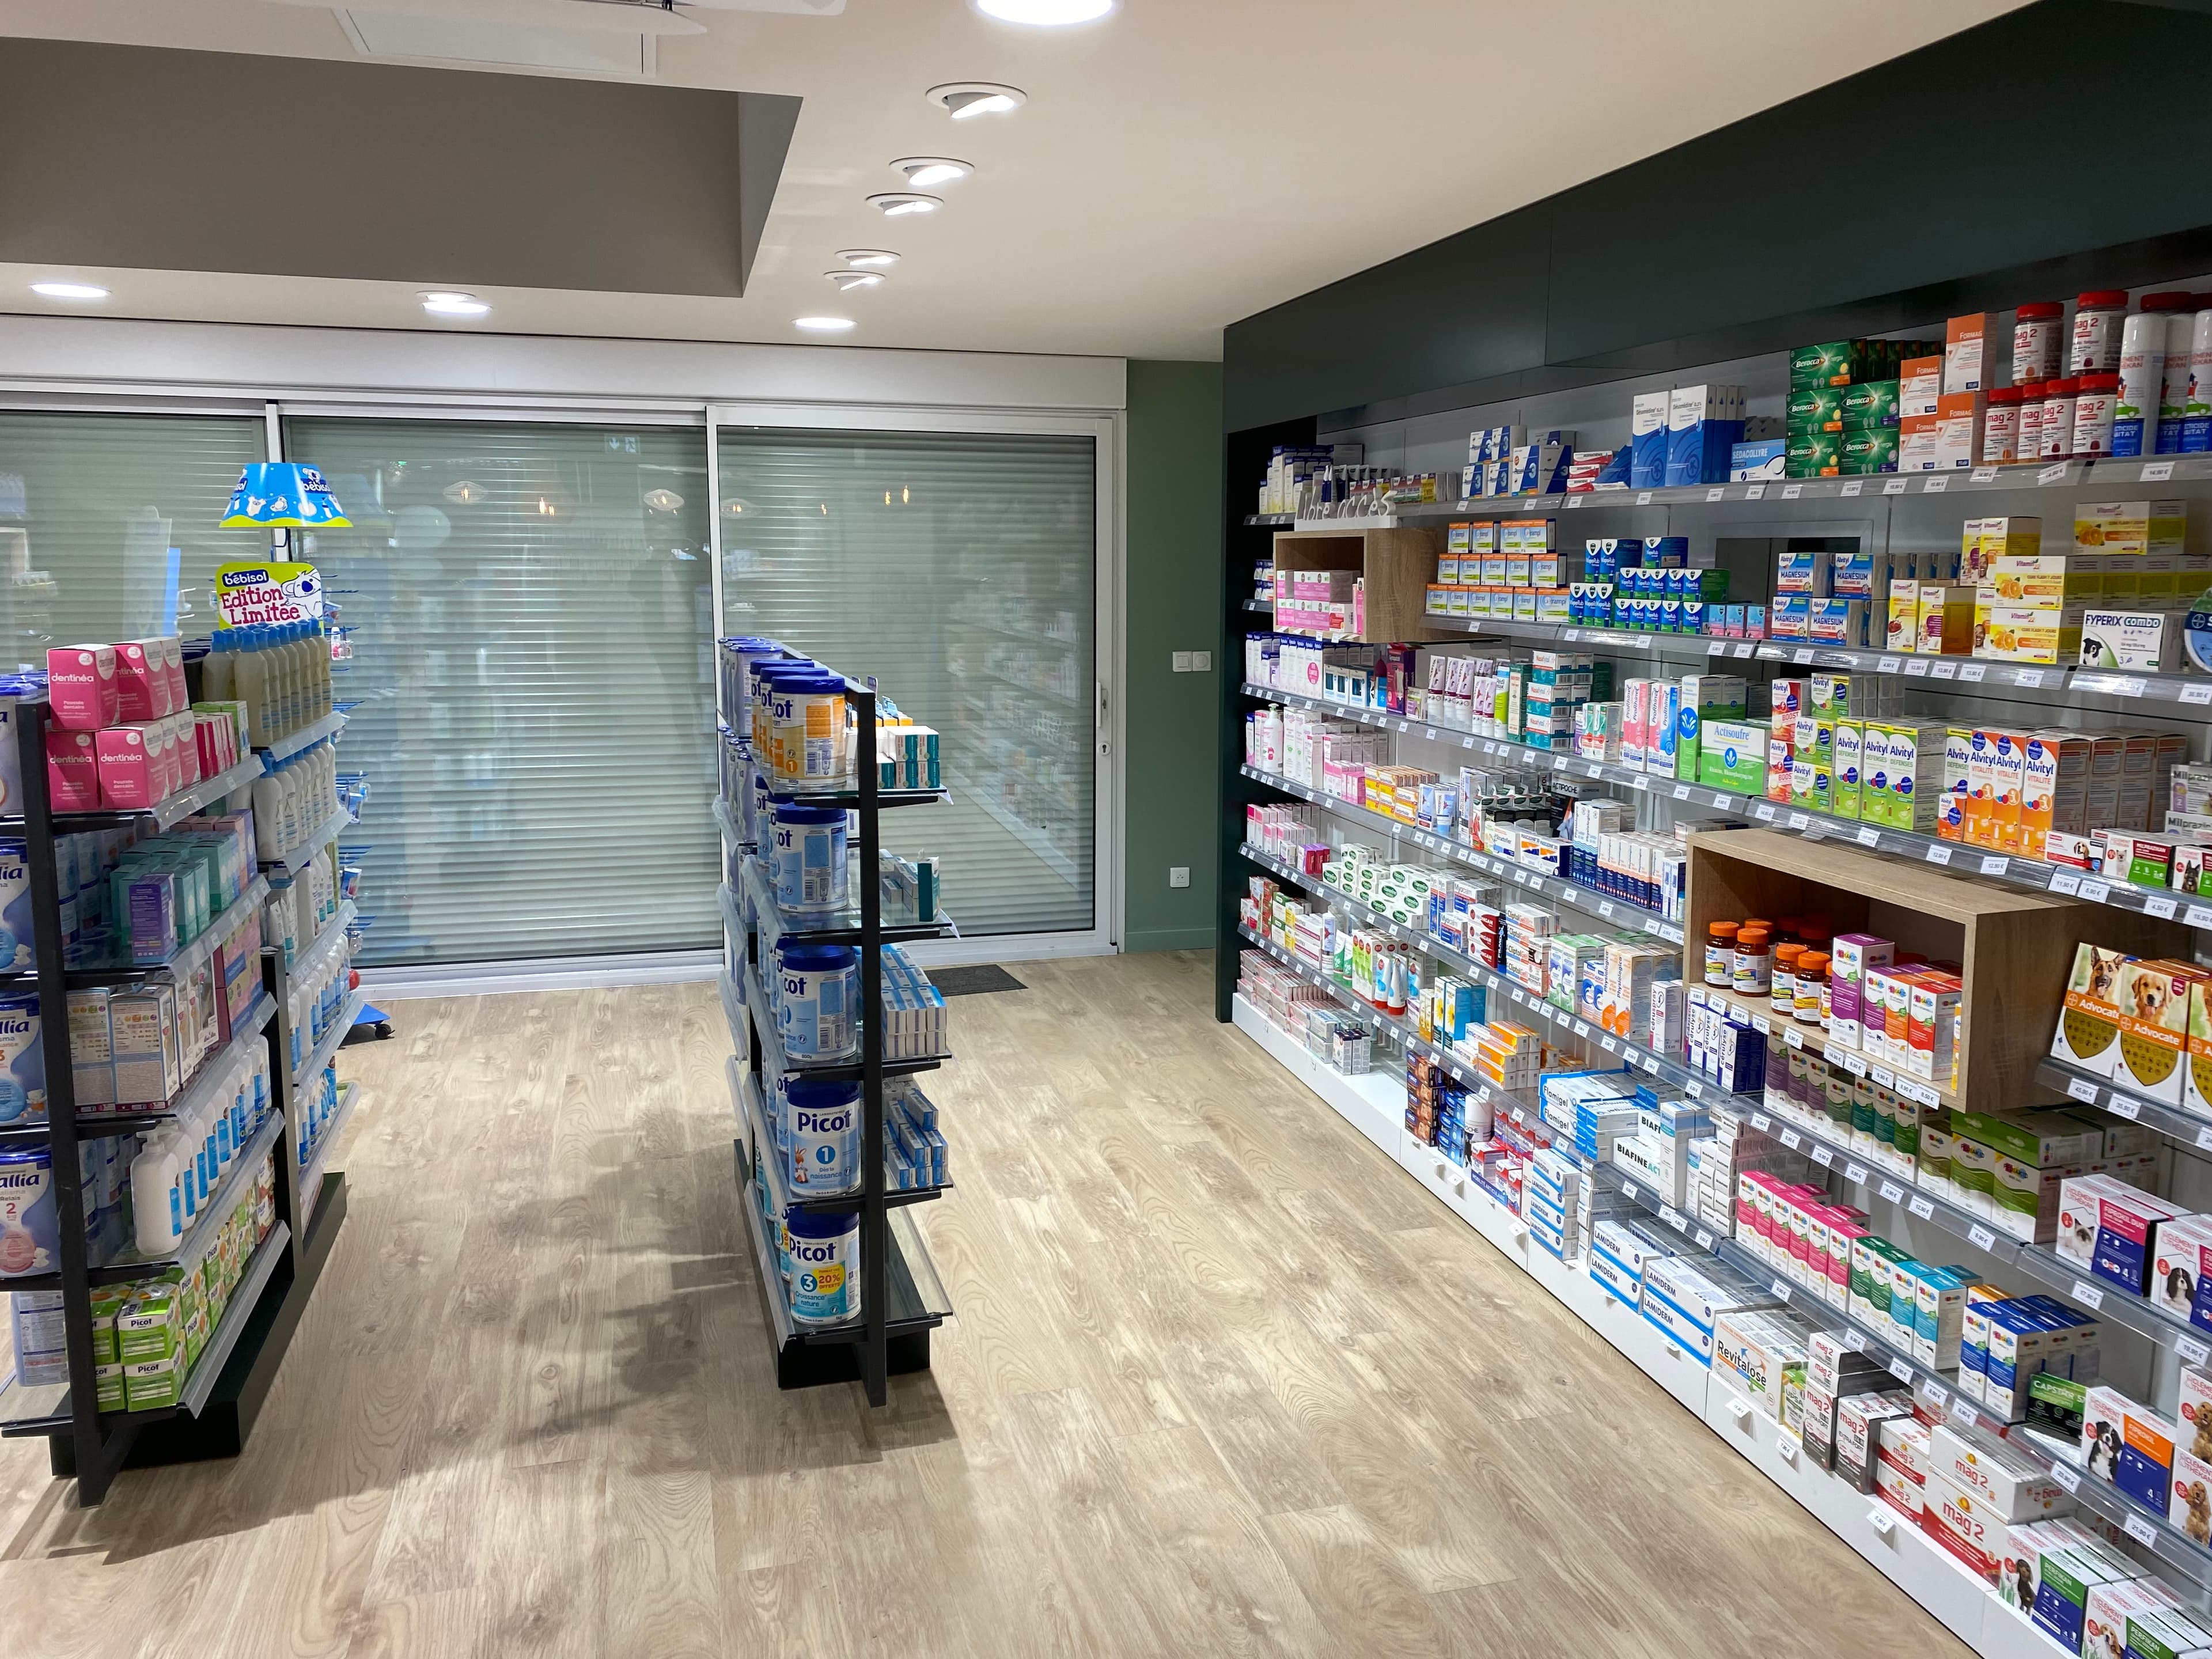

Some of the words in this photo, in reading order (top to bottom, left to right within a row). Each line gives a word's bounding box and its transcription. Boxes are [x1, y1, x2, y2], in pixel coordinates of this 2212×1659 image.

[2090, 317, 2099, 327] 2
[2030, 328, 2037, 338] 2
[2056, 404, 2065, 414] 2
[2077, 403, 2094, 413] mag
[2096, 400, 2105, 411] 2
[1987, 414, 2005, 424] mag
[2007, 412, 2015, 421] 2
[2022, 411, 2040, 421] mag
[1790, 448, 1812, 456] Berocca
[224, 573, 267, 585] bébisol
[219, 586, 284, 609] Edition
[229, 602, 301, 625] Limitée
[2085, 614, 2122, 627] FYPERIX
[2125, 618, 2160, 627] combo
[51, 673, 94, 682] dentinéa
[1813, 676, 1830, 688] Alvityl
[1773, 683, 1788, 693] Alvityl
[1782, 711, 1799, 721] BOOST
[1714, 725, 1749, 740] Actisoufre
[1797, 721, 1813, 733] Alvityl
[1771, 743, 1785, 753] Alvityl
[1838, 737, 1859, 751] Alvityl
[1866, 741, 1888, 756] Alvityl
[50, 753, 92, 763] dentinéa
[100, 753, 142, 762] dentinéa
[1890, 745, 1914, 760] Alvityl
[1947, 748, 1969, 763] Alvity
[1970, 751, 1996, 767] Alvityl
[1794, 765, 1811, 776] Alvityl
[1997, 756, 2021, 771] Alvityl
[2026, 760, 2054, 777] Alvityl
[1778, 773, 1792, 781] BOOS
[1552, 782, 1578, 794] ACTIPOCHE
[2134, 1023, 2180, 1046] Advocate
[1544, 1085, 1569, 1107] Flamigel
[797, 1110, 851, 1132] Picot
[1545, 1108, 1569, 1130] Flamigel
[821, 1147, 830, 1162] 1
[0, 1173, 40, 1188] allia
[1532, 1179, 1550, 1197] LAMIDERM
[6, 1202, 16, 1214] 2
[1531, 1200, 1549, 1218] LAMIDERM
[1530, 1221, 1548, 1239] LAMIDERM
[790, 1236, 836, 1262] Picot
[1594, 1229, 1621, 1256] LAMIDERM
[1592, 1257, 1618, 1284] LAMIDERM
[803, 1275, 813, 1290] 3
[819, 1274, 840, 1284] 20%
[1646, 1269, 1676, 1297] LAMIDERM
[1644, 1297, 1673, 1326] LAMIDERM
[131, 1319, 151, 1327] Picot
[1815, 1340, 1828, 1355] mag
[1828, 1348, 1834, 1356] 2
[138, 1363, 160, 1373] Picot
[1718, 1340, 1767, 1387] Revitalose
[1815, 1362, 1827, 1377] mag
[1827, 1370, 1832, 1378] 2
[1786, 1388, 1804, 1408] UPSA
[1806, 1390, 1823, 1410] mag
[1824, 1402, 1830, 1414] 2
[1926, 1403, 1942, 1421] mag
[1942, 1414, 1948, 1423] 2
[1839, 1411, 1858, 1431] mag
[1858, 1423, 1865, 1437] 2
[1893, 1445, 1908, 1463] mag
[1908, 1456, 1915, 1466] 2
[1955, 1459, 1979, 1487] mag
[1979, 1474, 1989, 1490] 2
[1889, 1483, 1905, 1501] mag
[1905, 1494, 1911, 1504] 2
[2147, 1488, 2154, 1498] 4
[1943, 1502, 1972, 1537] mag
[1975, 1523, 1985, 1543] 2
